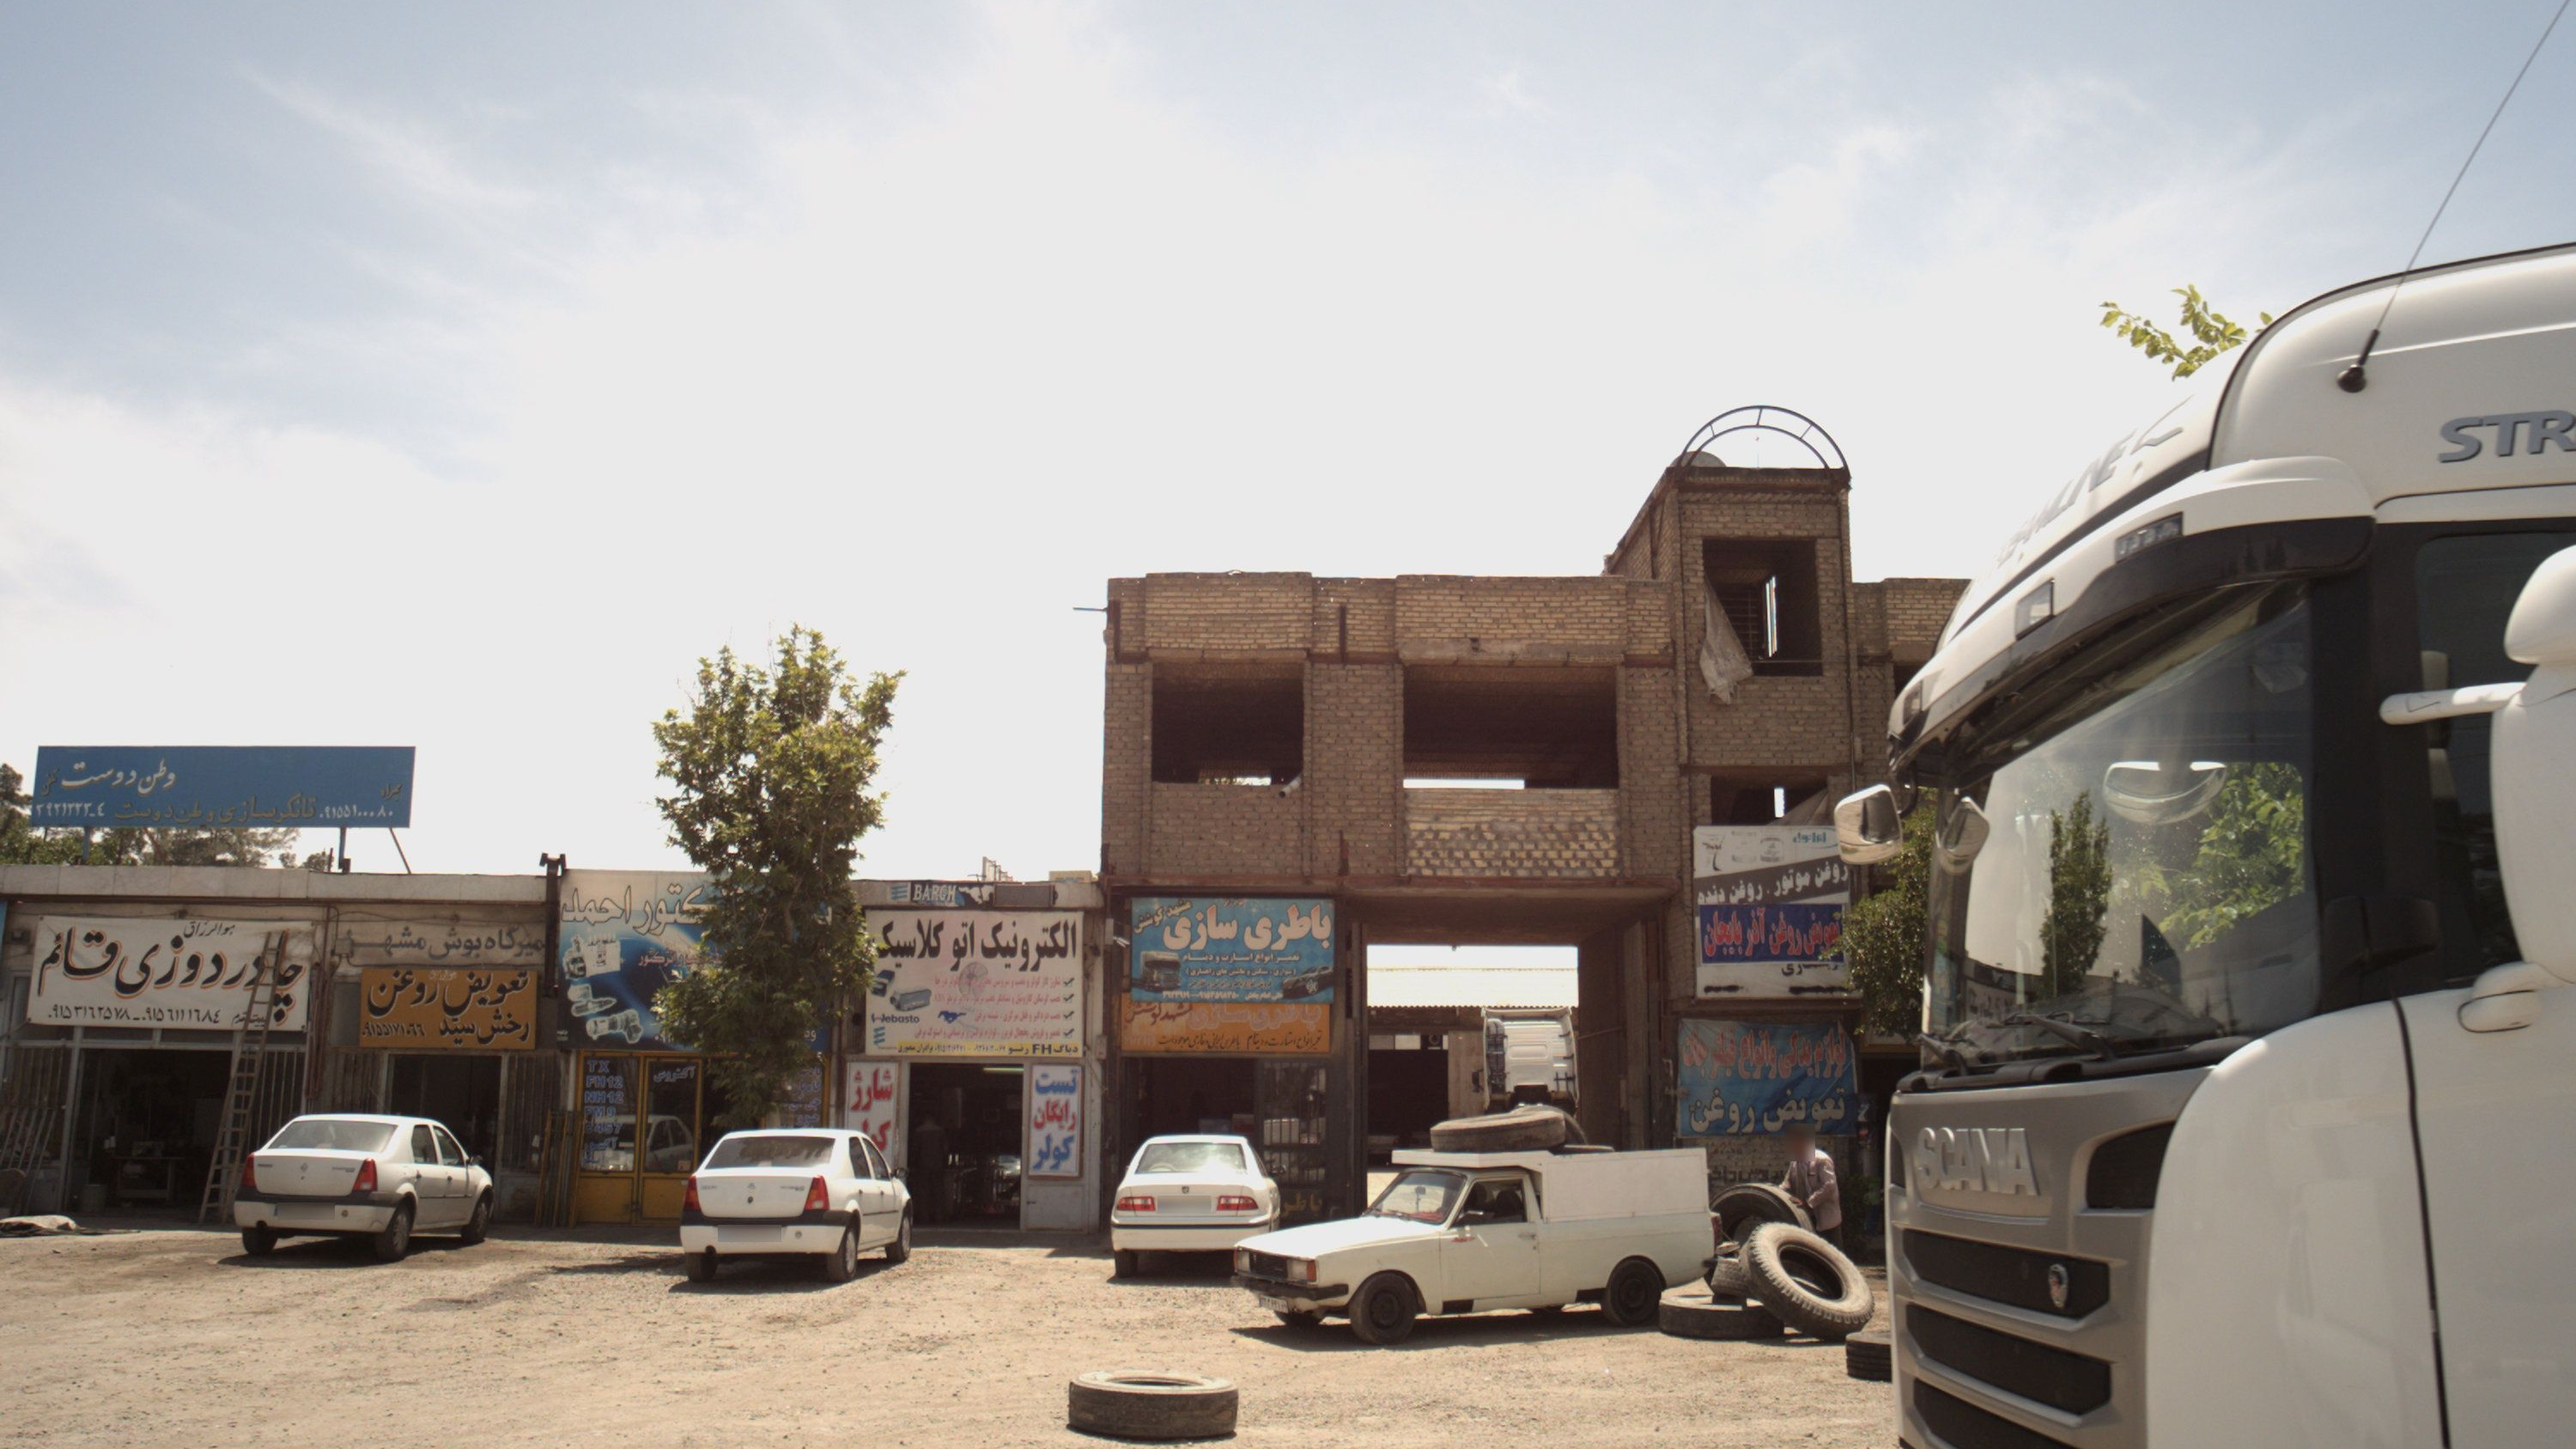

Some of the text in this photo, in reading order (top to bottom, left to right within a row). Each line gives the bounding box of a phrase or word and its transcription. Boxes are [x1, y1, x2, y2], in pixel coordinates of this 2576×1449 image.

[61, 758, 177, 795] وطن دوست
[913, 884, 957, 902] BARGH
[1728, 880, 1763, 904] روغن
[1773, 861, 1849, 897] روغن موتور
[562, 884, 632, 926] احمد
[874, 918, 1078, 972] الکترونیک اتو کلاسیک
[1163, 903, 1332, 951] باطری سازی
[1769, 910, 1802, 956] روغن
[1255, 953, 1274, 964] انواع
[367, 970, 530, 1020] تعویض روغن
[477, 1007, 532, 1045] رخش
[871, 1013, 920, 1026] Webasto
[1032, 1044, 1052, 1056] FH
[851, 1068, 894, 1111] شارژ
[1034, 1068, 1079, 1095] تست
[1032, 1098, 1078, 1131] رایگان
[1690, 1087, 1756, 1134] روغن
[1763, 1087, 1845, 1133] تعویض
[1032, 1133, 1075, 1170] کولر
[1916, 1126, 2041, 1196] SCANIA
[1283, 1191, 1323, 1218] باطر
